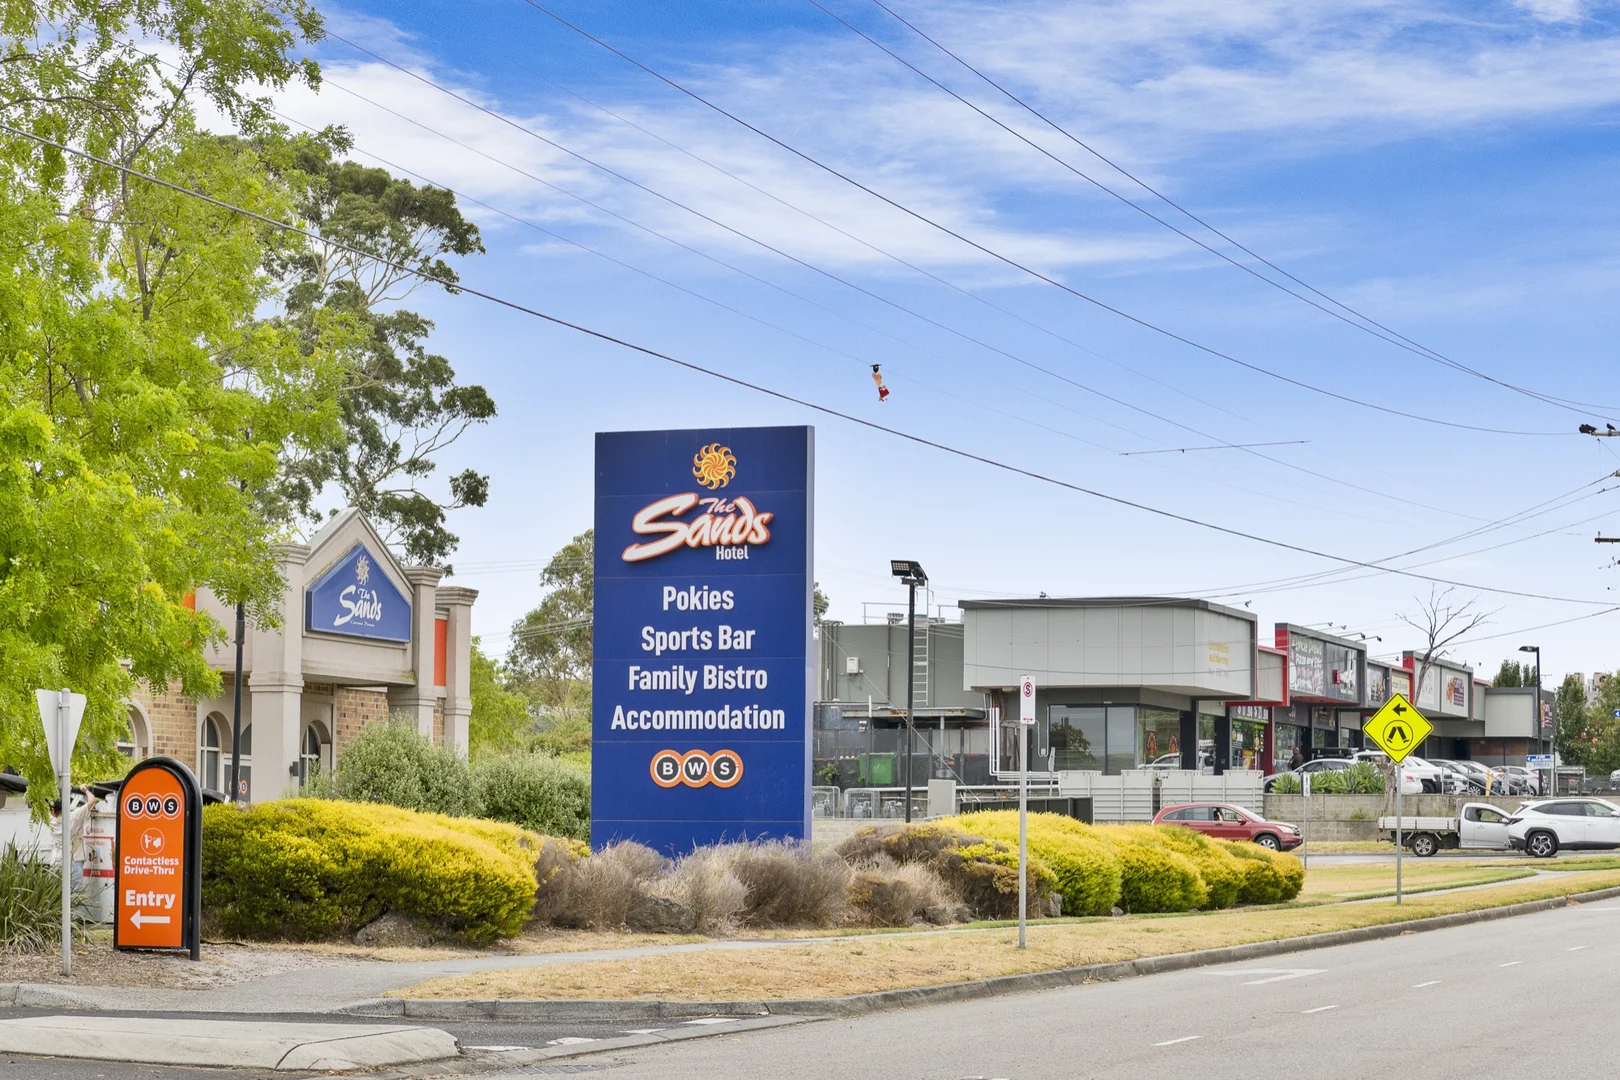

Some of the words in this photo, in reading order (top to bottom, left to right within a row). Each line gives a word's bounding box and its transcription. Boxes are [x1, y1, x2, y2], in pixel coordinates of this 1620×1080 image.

[698, 496, 736, 514] The
[621, 491, 774, 562] Sands
[715, 545, 749, 560] Hotel
[333, 584, 382, 627] Sands
[357, 588, 370, 600] The
[662, 585, 735, 611] Pokies
[641, 625, 713, 656] Sports
[718, 625, 756, 650] Bar
[628, 665, 698, 695] Family
[703, 664, 768, 690] Bistro
[610, 704, 785, 730] Accommodation
[124, 855, 179, 866] Contactless
[124, 865, 175, 875] Drive-Thru
[125, 889, 176, 909] Entry
